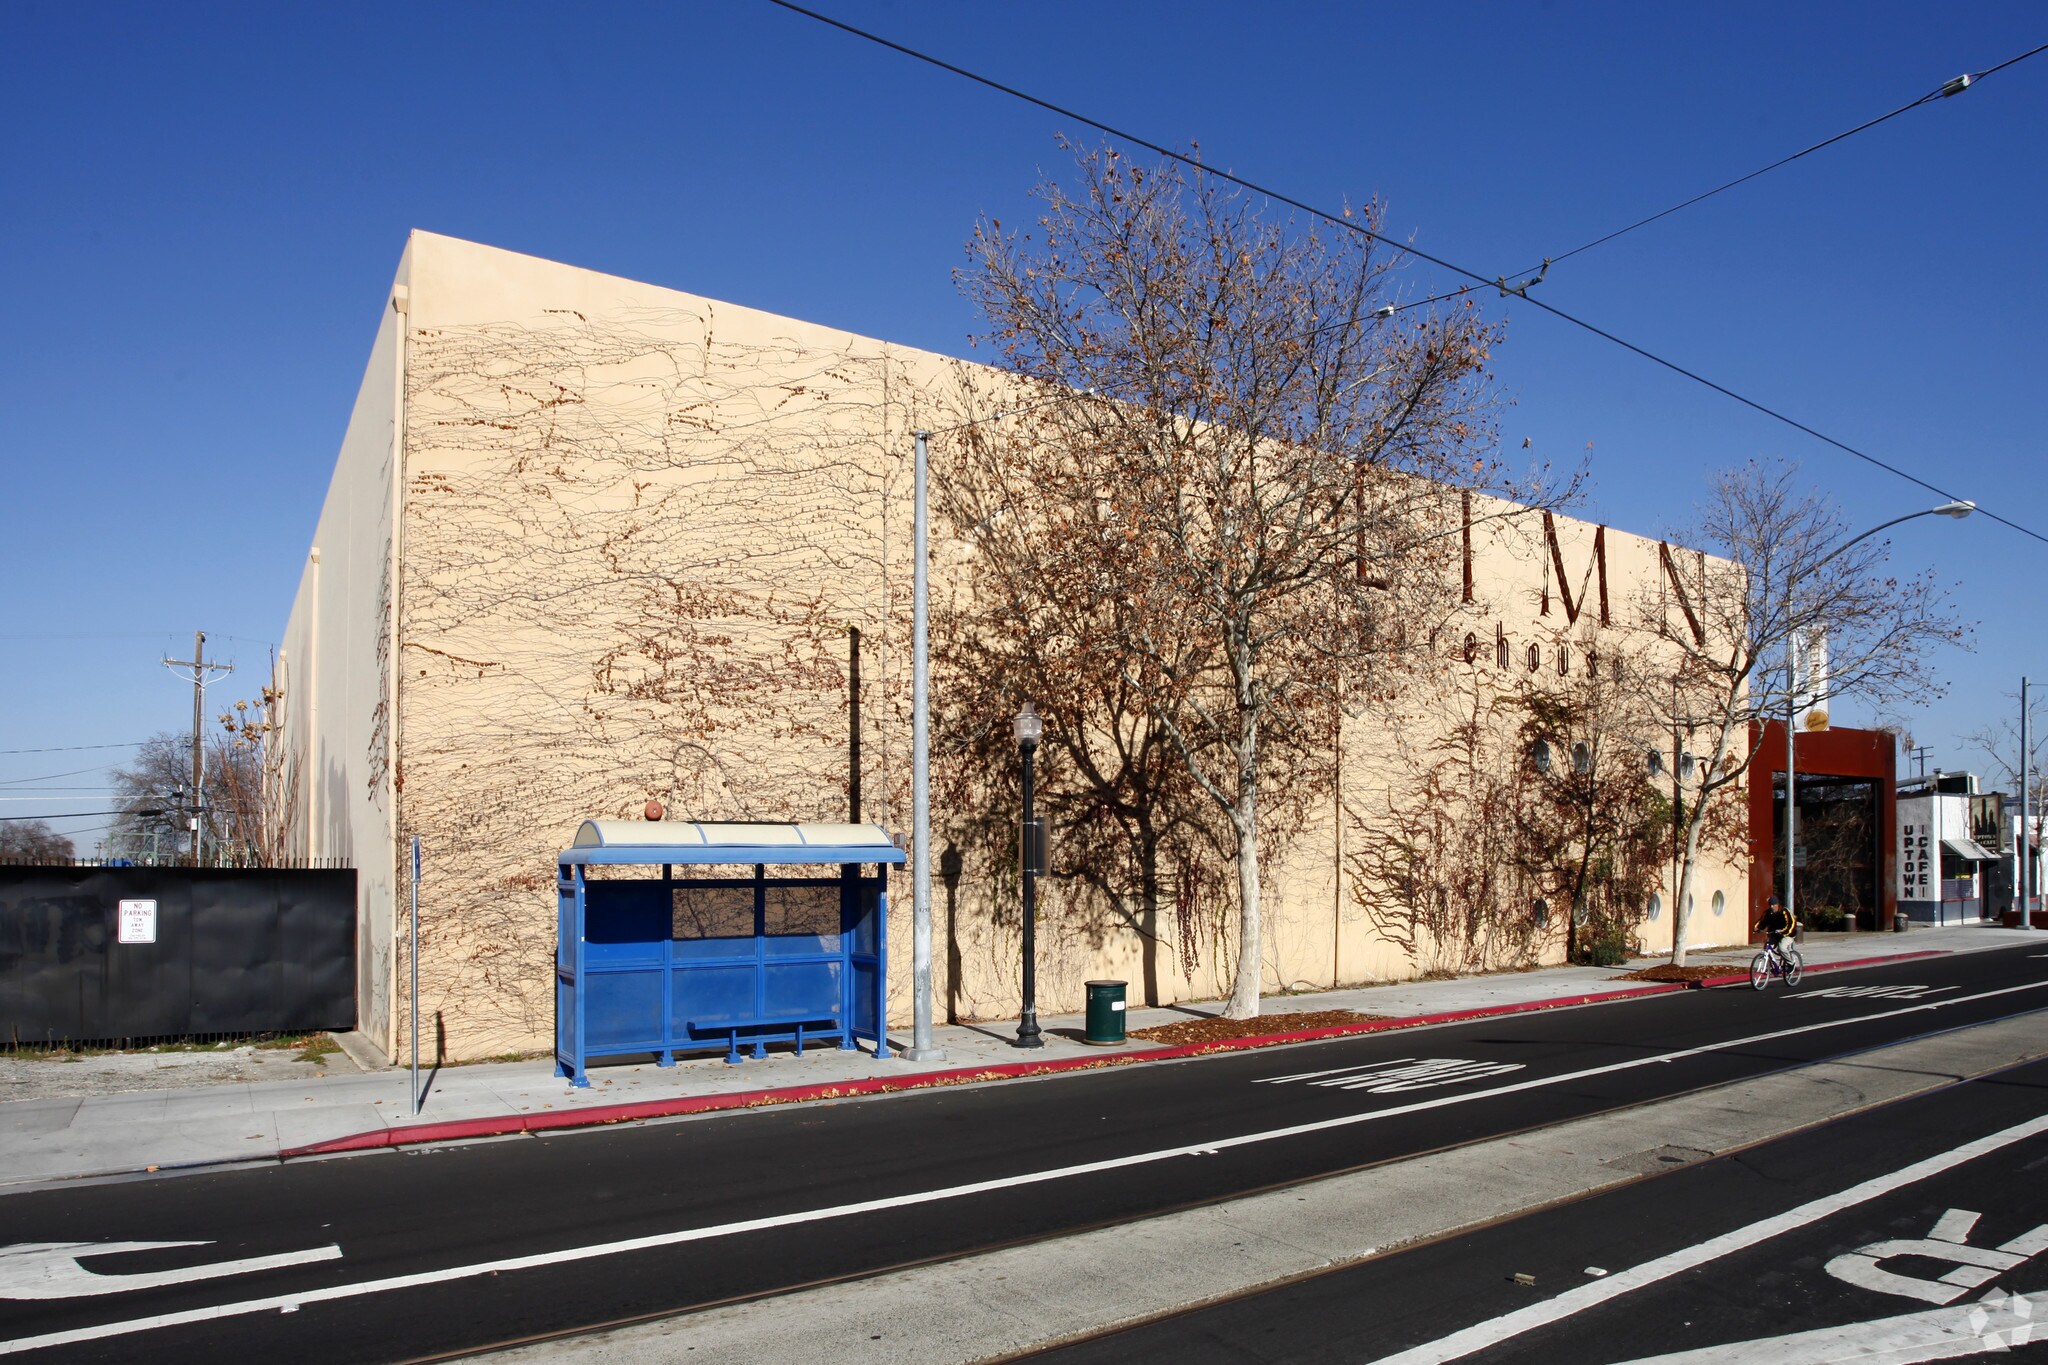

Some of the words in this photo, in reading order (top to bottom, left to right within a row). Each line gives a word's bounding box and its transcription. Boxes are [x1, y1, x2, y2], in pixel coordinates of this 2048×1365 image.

[1903, 825, 1915, 898] UPTOWN
[1918, 837, 1928, 885] CAFE
[1251, 1058, 1526, 1093] ONLY
